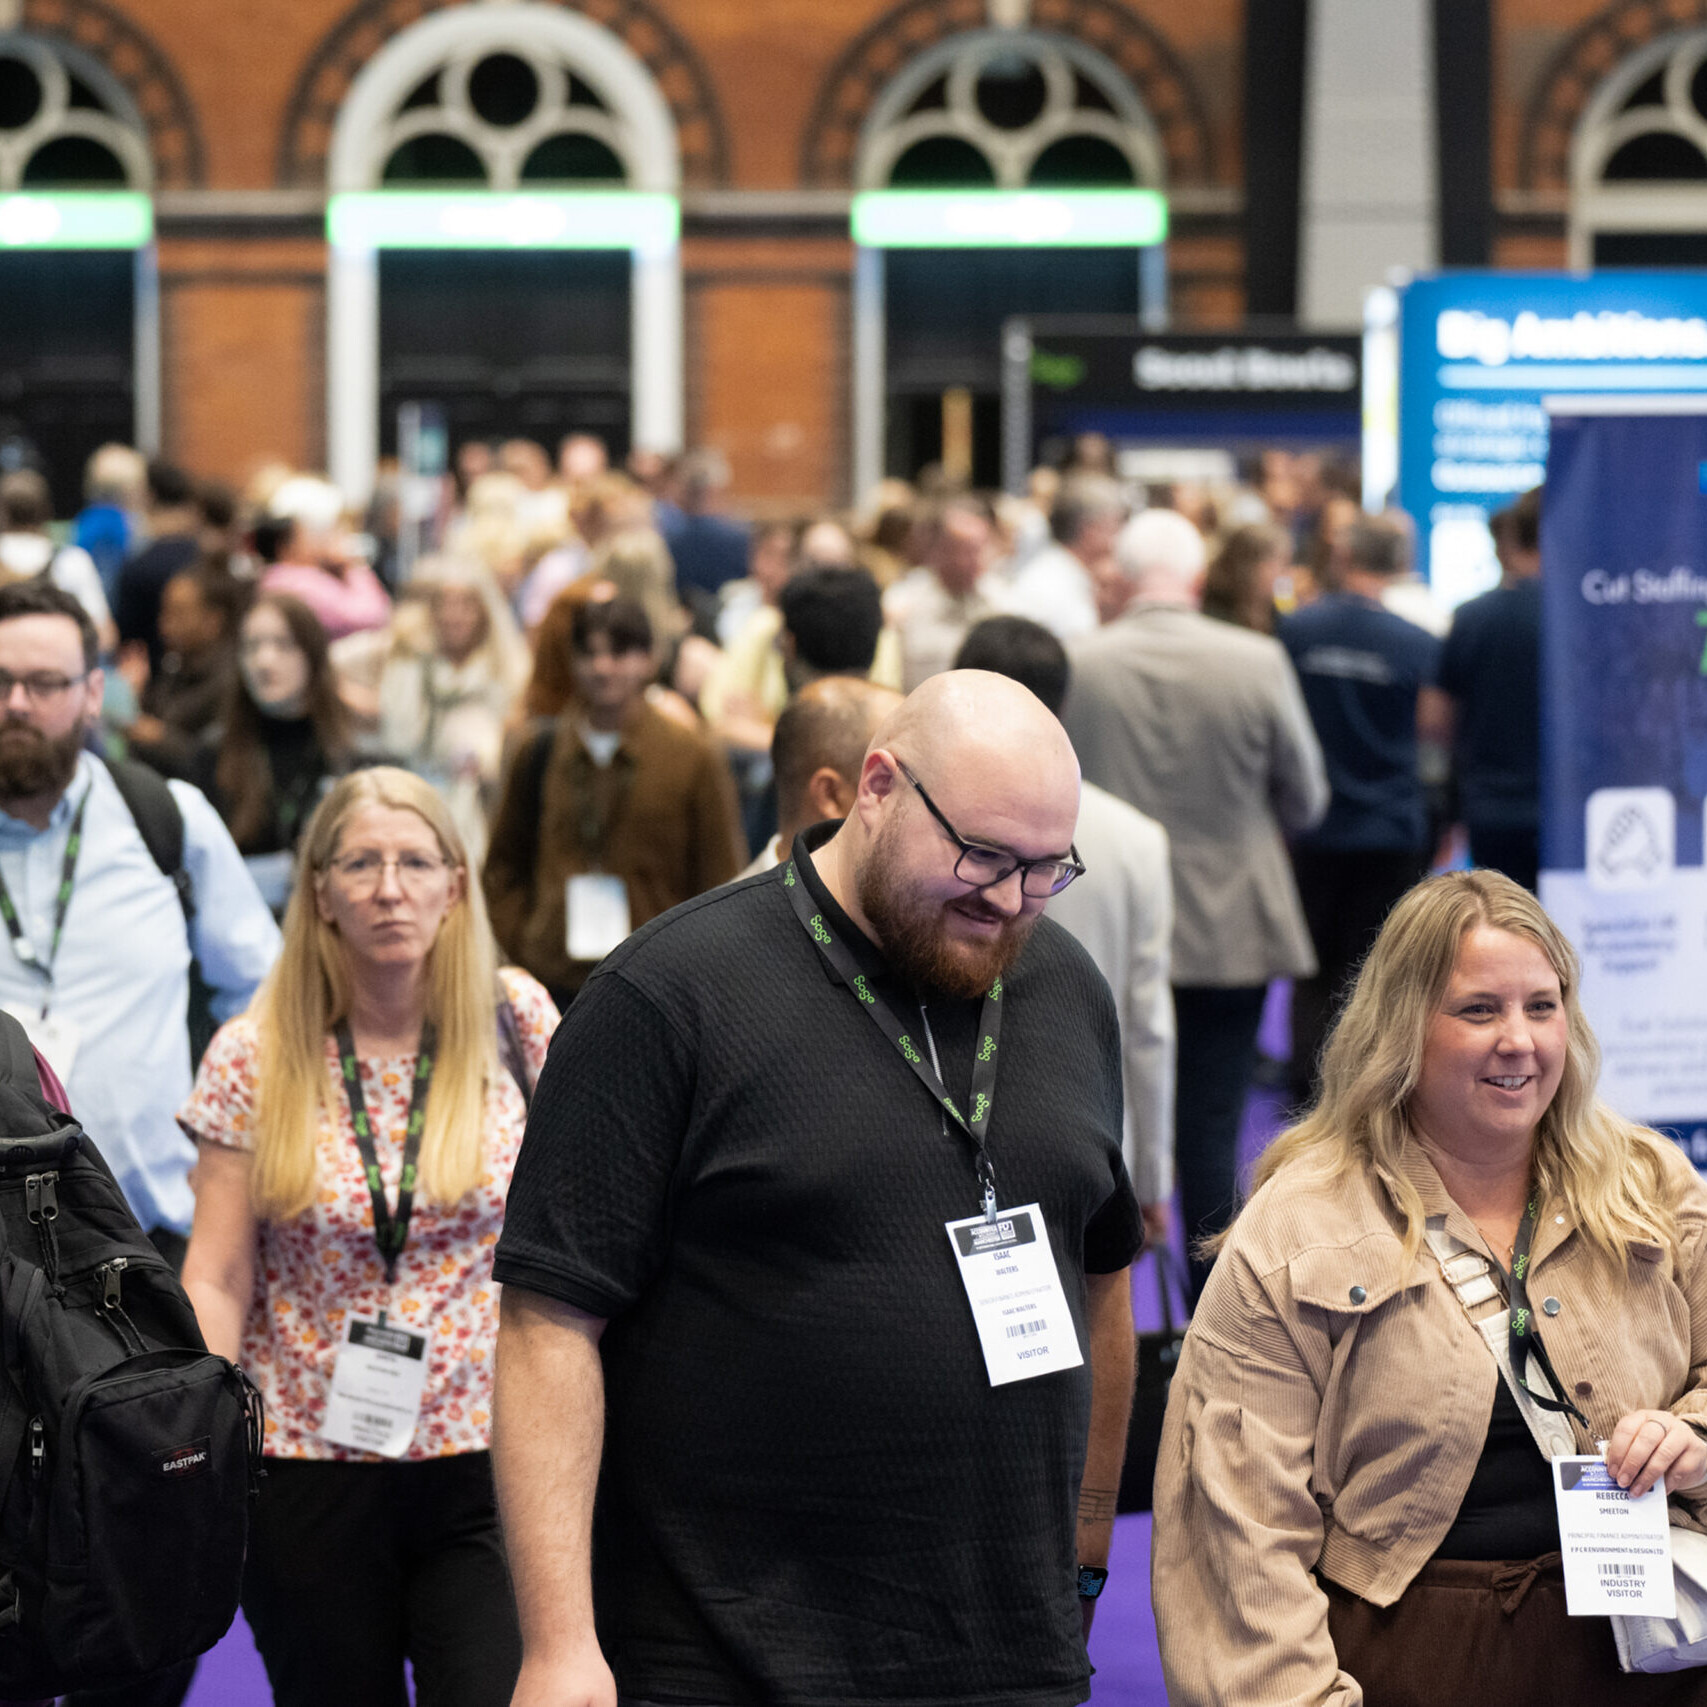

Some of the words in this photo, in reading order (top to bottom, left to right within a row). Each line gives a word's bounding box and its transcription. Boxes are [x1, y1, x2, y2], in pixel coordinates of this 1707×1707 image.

[810, 914, 832, 944] Sage
[853, 975, 876, 1004] Sage
[898, 1035, 920, 1063] Sage
[971, 1093, 990, 1122] Sage
[993, 1250, 1011, 1261] ISAAC
[996, 1265, 1019, 1275] WALTERS
[1511, 1308, 1530, 1336] Sage
[1017, 1345, 1049, 1360] VISITOR
[162, 1452, 206, 1471] EASTPAK
[1596, 1492, 1630, 1501] REBECCA
[1600, 1579, 1646, 1588] INDUSTRY
[1607, 1589, 1643, 1598] VISITOR
